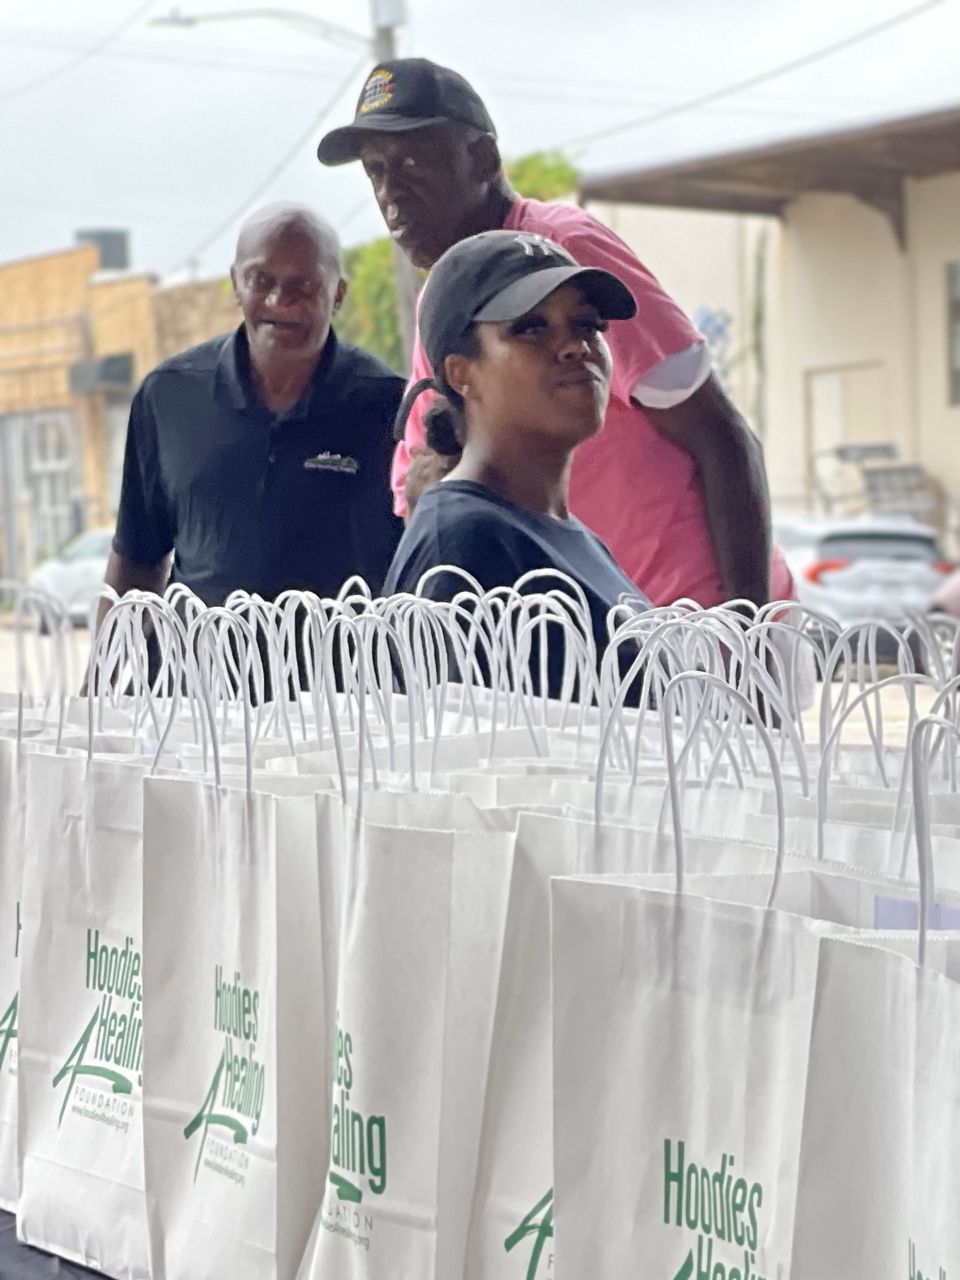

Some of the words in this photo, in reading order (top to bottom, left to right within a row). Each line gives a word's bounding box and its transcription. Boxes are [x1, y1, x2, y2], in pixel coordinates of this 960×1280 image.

[214, 964, 260, 1042] Hoodies
[53, 1004, 133, 1130] 4
[95, 994, 143, 1087] Healin
[183, 1048, 248, 1187] 4
[222, 1035, 265, 1137] Healing
[331, 1089, 387, 1195] aling
[663, 1138, 763, 1251] Hoodies
